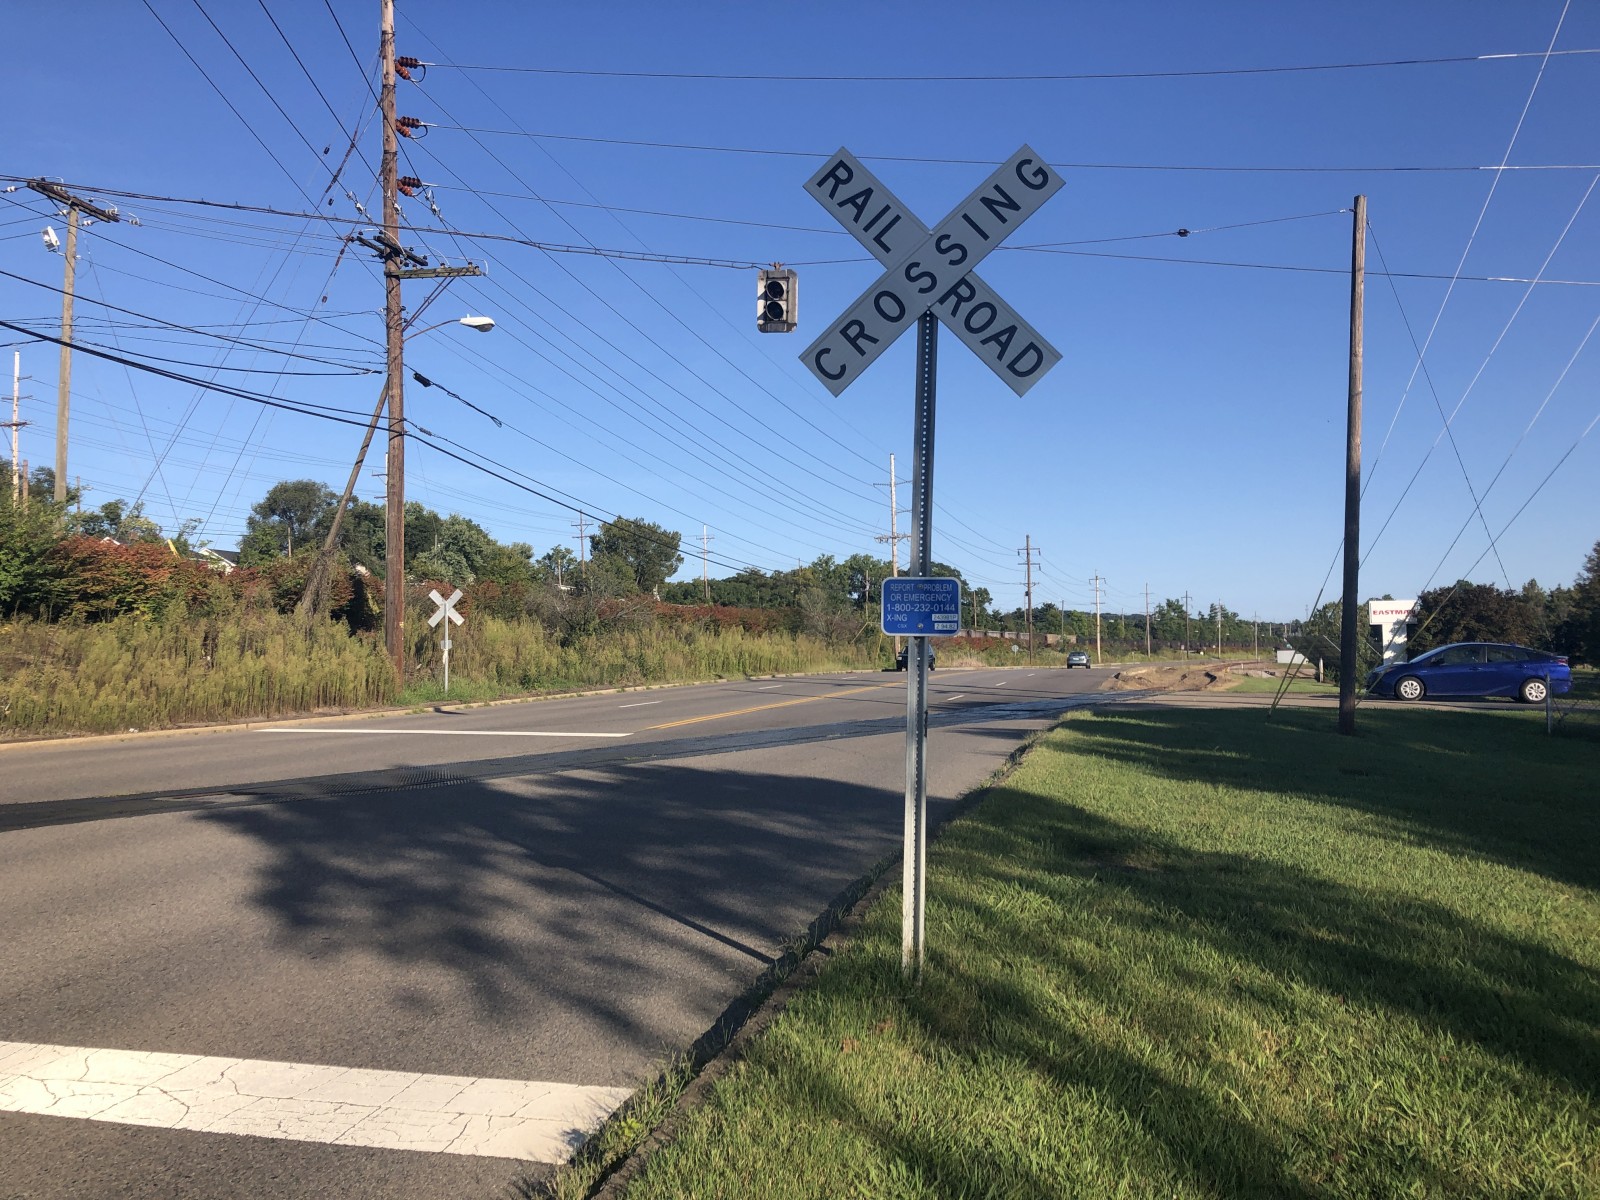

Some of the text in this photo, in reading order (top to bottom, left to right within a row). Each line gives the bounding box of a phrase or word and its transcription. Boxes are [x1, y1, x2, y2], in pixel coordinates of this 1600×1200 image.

[816, 159, 902, 254] RAIL
[814, 158, 1049, 381] CROSSING
[938, 277, 1044, 378] ROAD
[890, 584, 914, 592] REPORT
[924, 584, 952, 592] PROBLEM
[890, 594, 952, 602] OR EMERGENCY
[886, 604, 955, 612] 1-800-232-0144
[886, 614, 908, 622] X-ING
